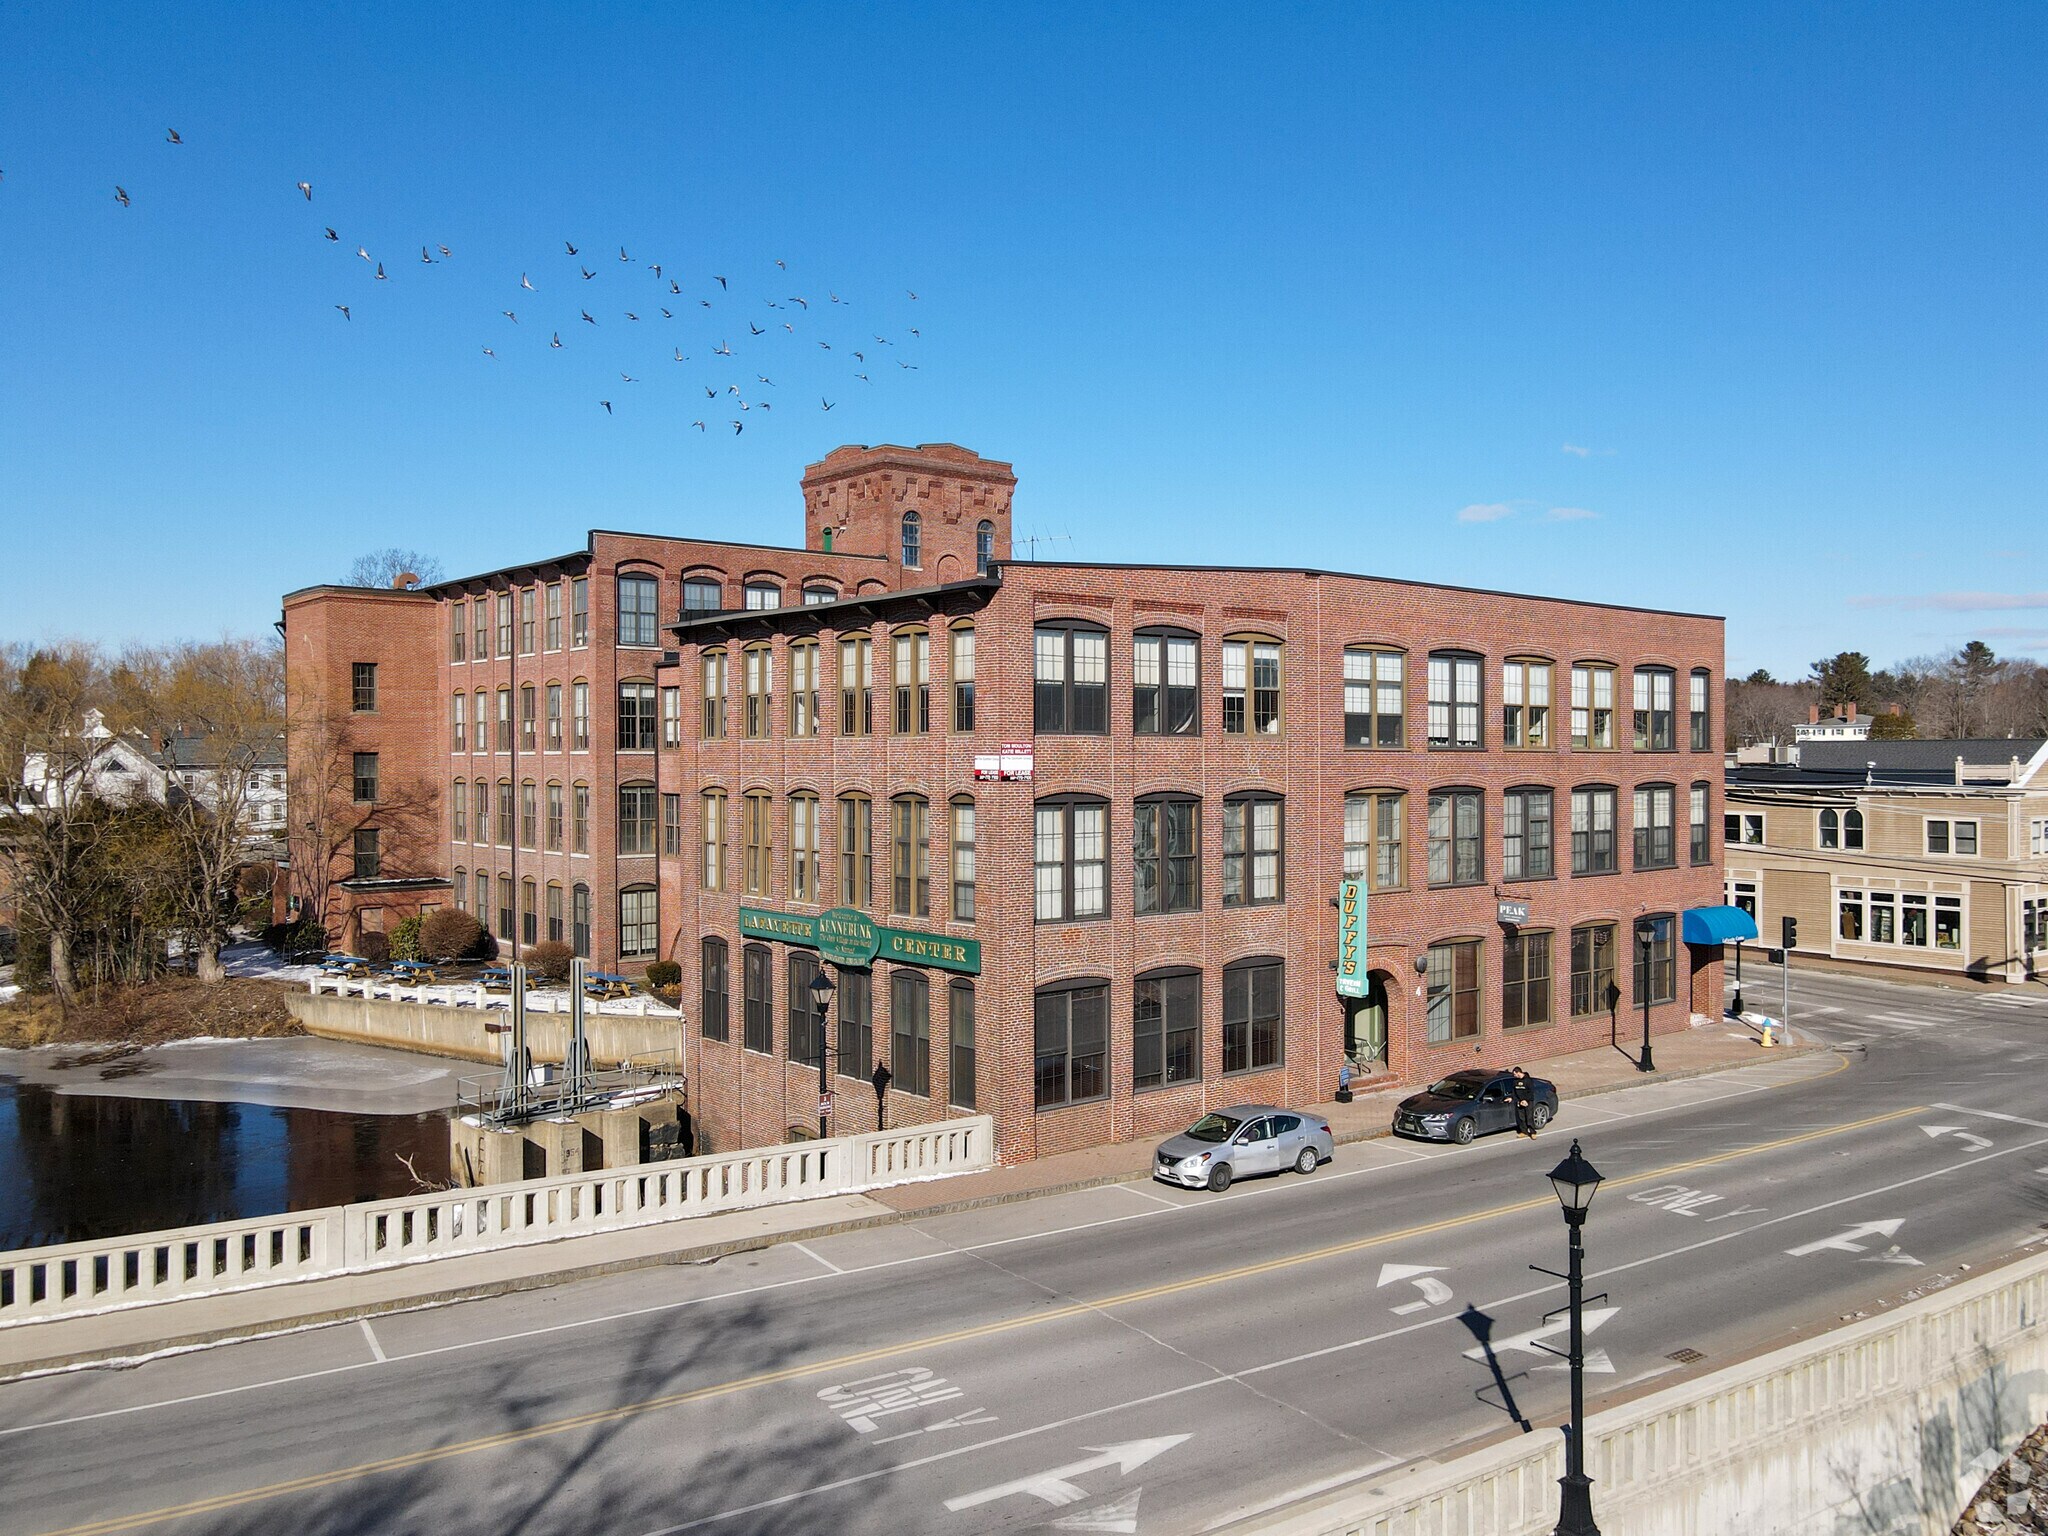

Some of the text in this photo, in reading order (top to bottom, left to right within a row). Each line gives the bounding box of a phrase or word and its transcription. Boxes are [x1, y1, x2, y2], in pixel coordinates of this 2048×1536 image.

[1500, 904, 1526, 916] PEAK
[743, 914, 812, 938] LAFAYETTE
[820, 918, 872, 939] KENNEBUNK
[1343, 884, 1358, 975] DUFFY'S
[892, 936, 967, 962] CENTER
[1626, 1185, 1768, 1222] ONLY
[816, 1367, 999, 1445] ONLY
